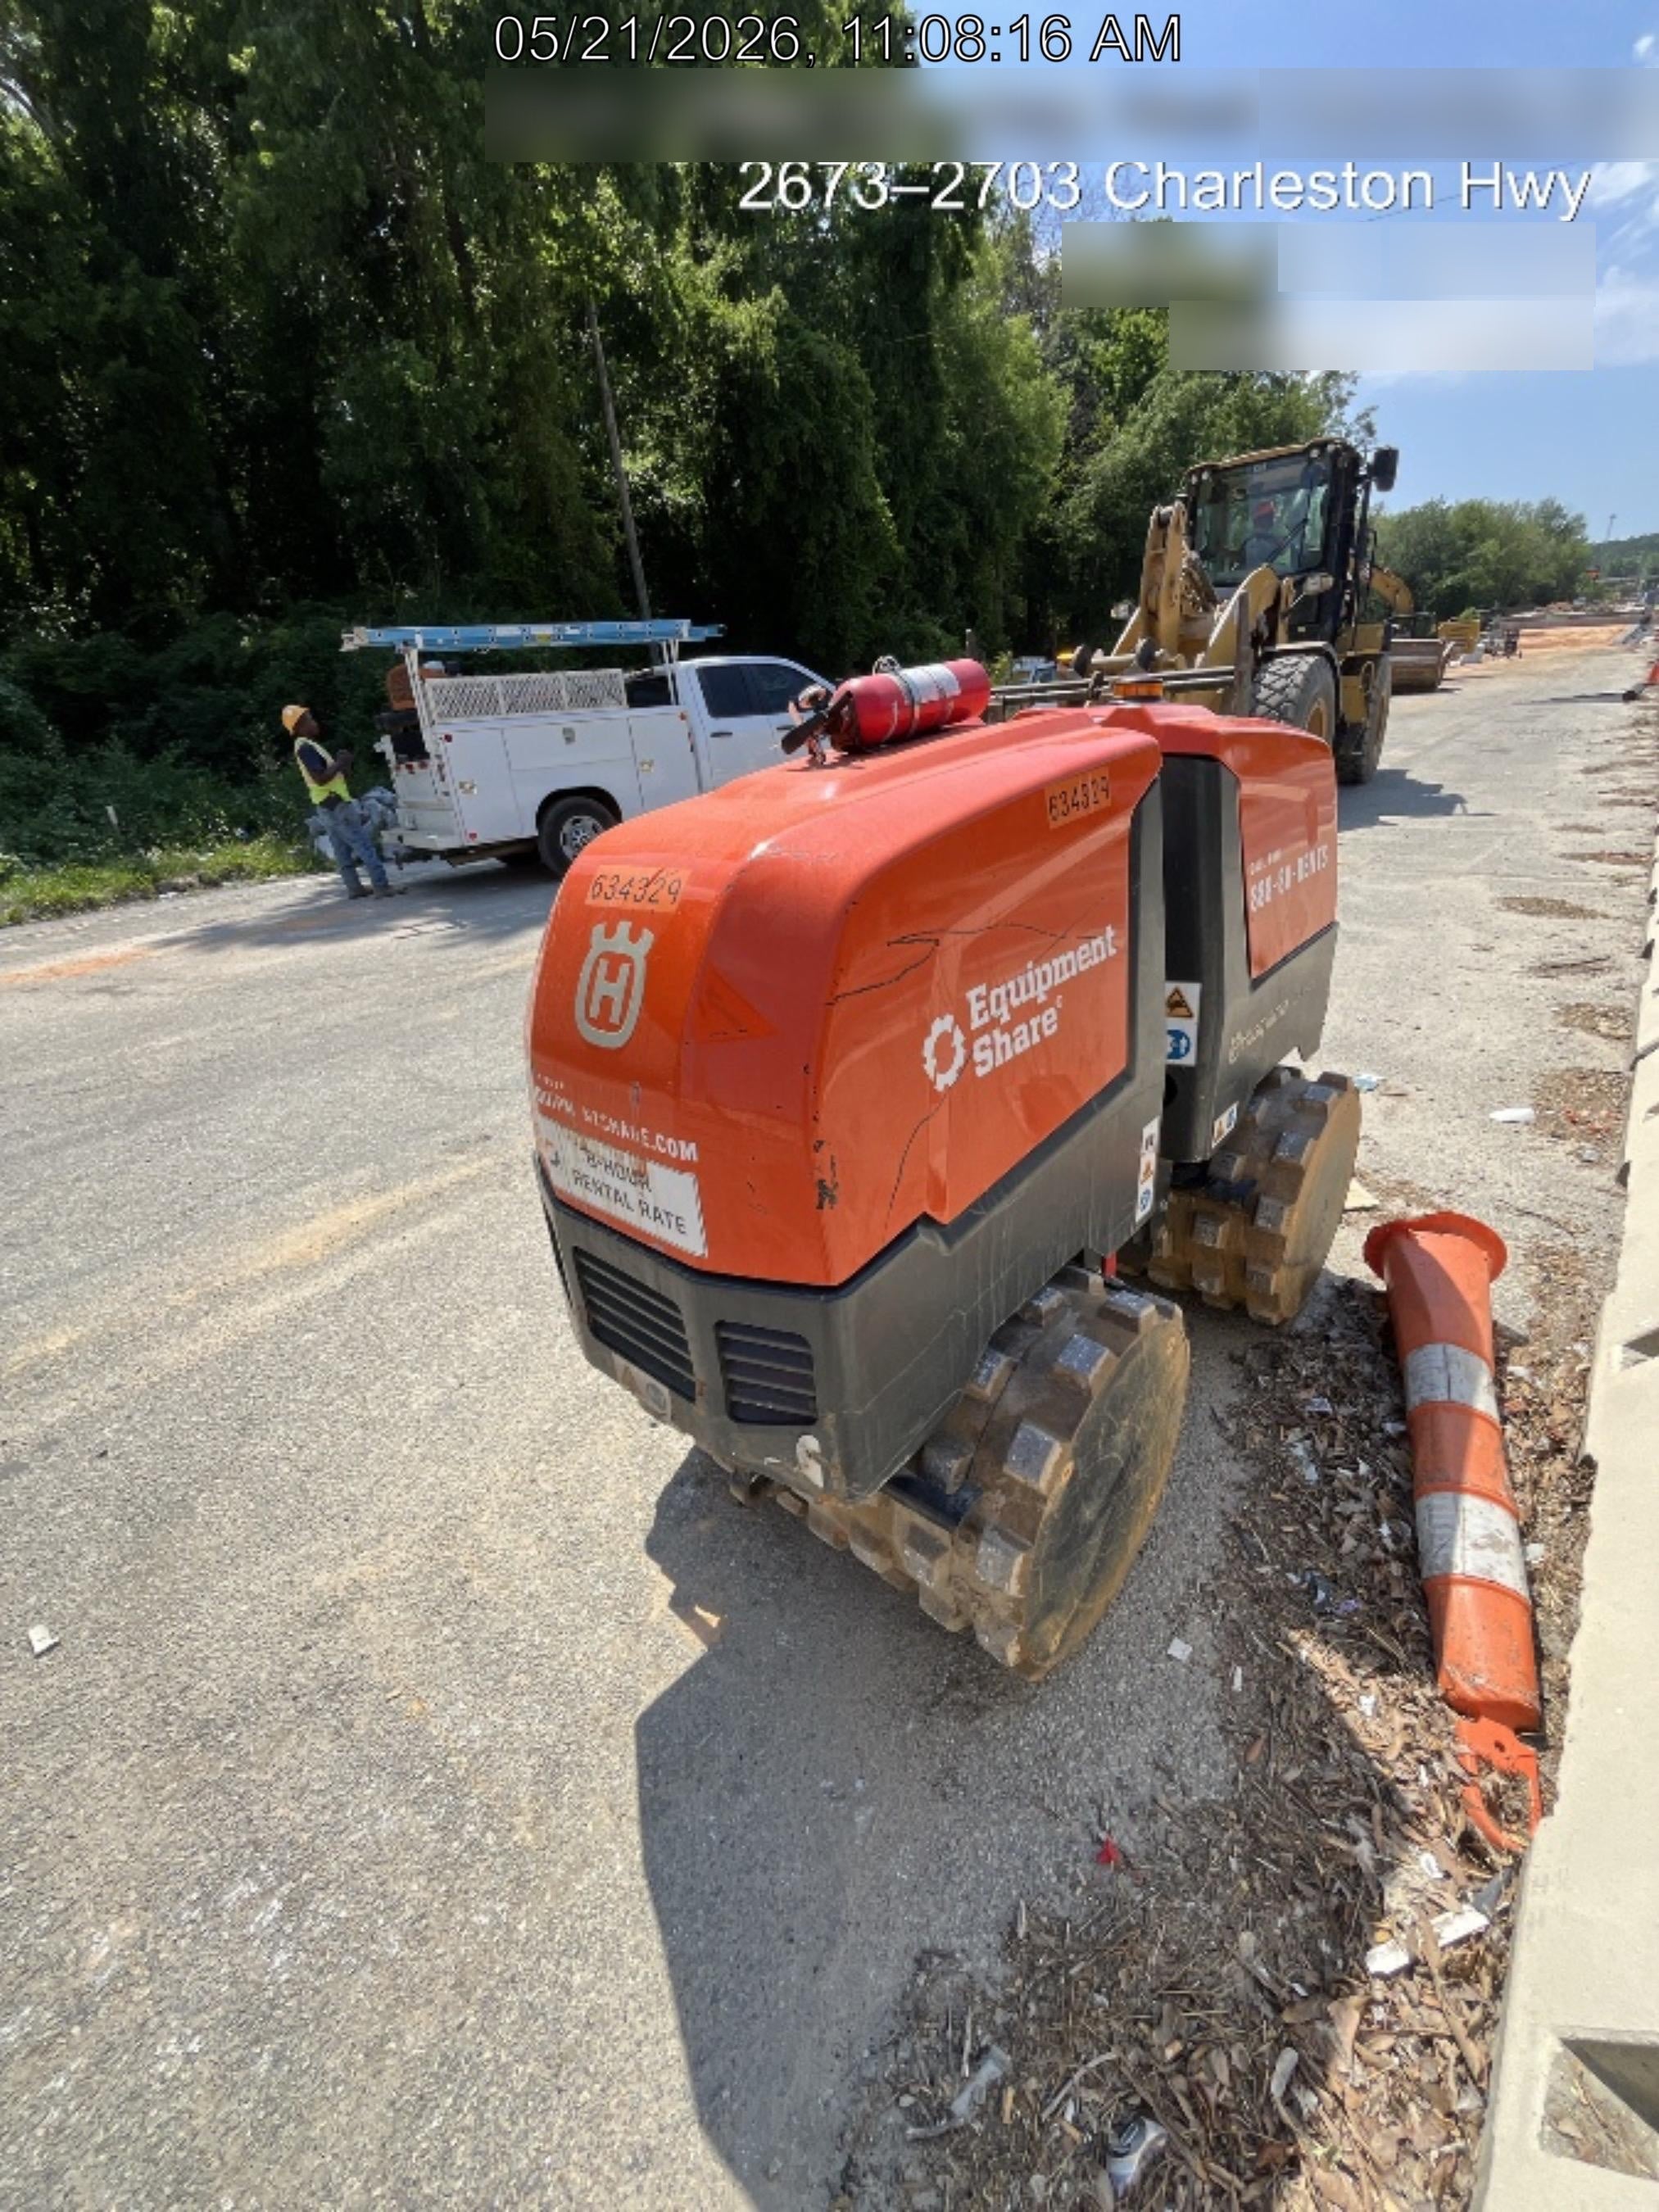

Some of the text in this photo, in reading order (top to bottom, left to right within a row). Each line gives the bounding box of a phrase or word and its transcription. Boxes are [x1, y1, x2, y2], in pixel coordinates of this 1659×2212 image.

[591, 873, 682, 905] 634329
[965, 924, 1117, 1031] Equipment
[972, 1007, 1058, 1078] Share
[572, 1169, 687, 1235] RENTAL RATE
